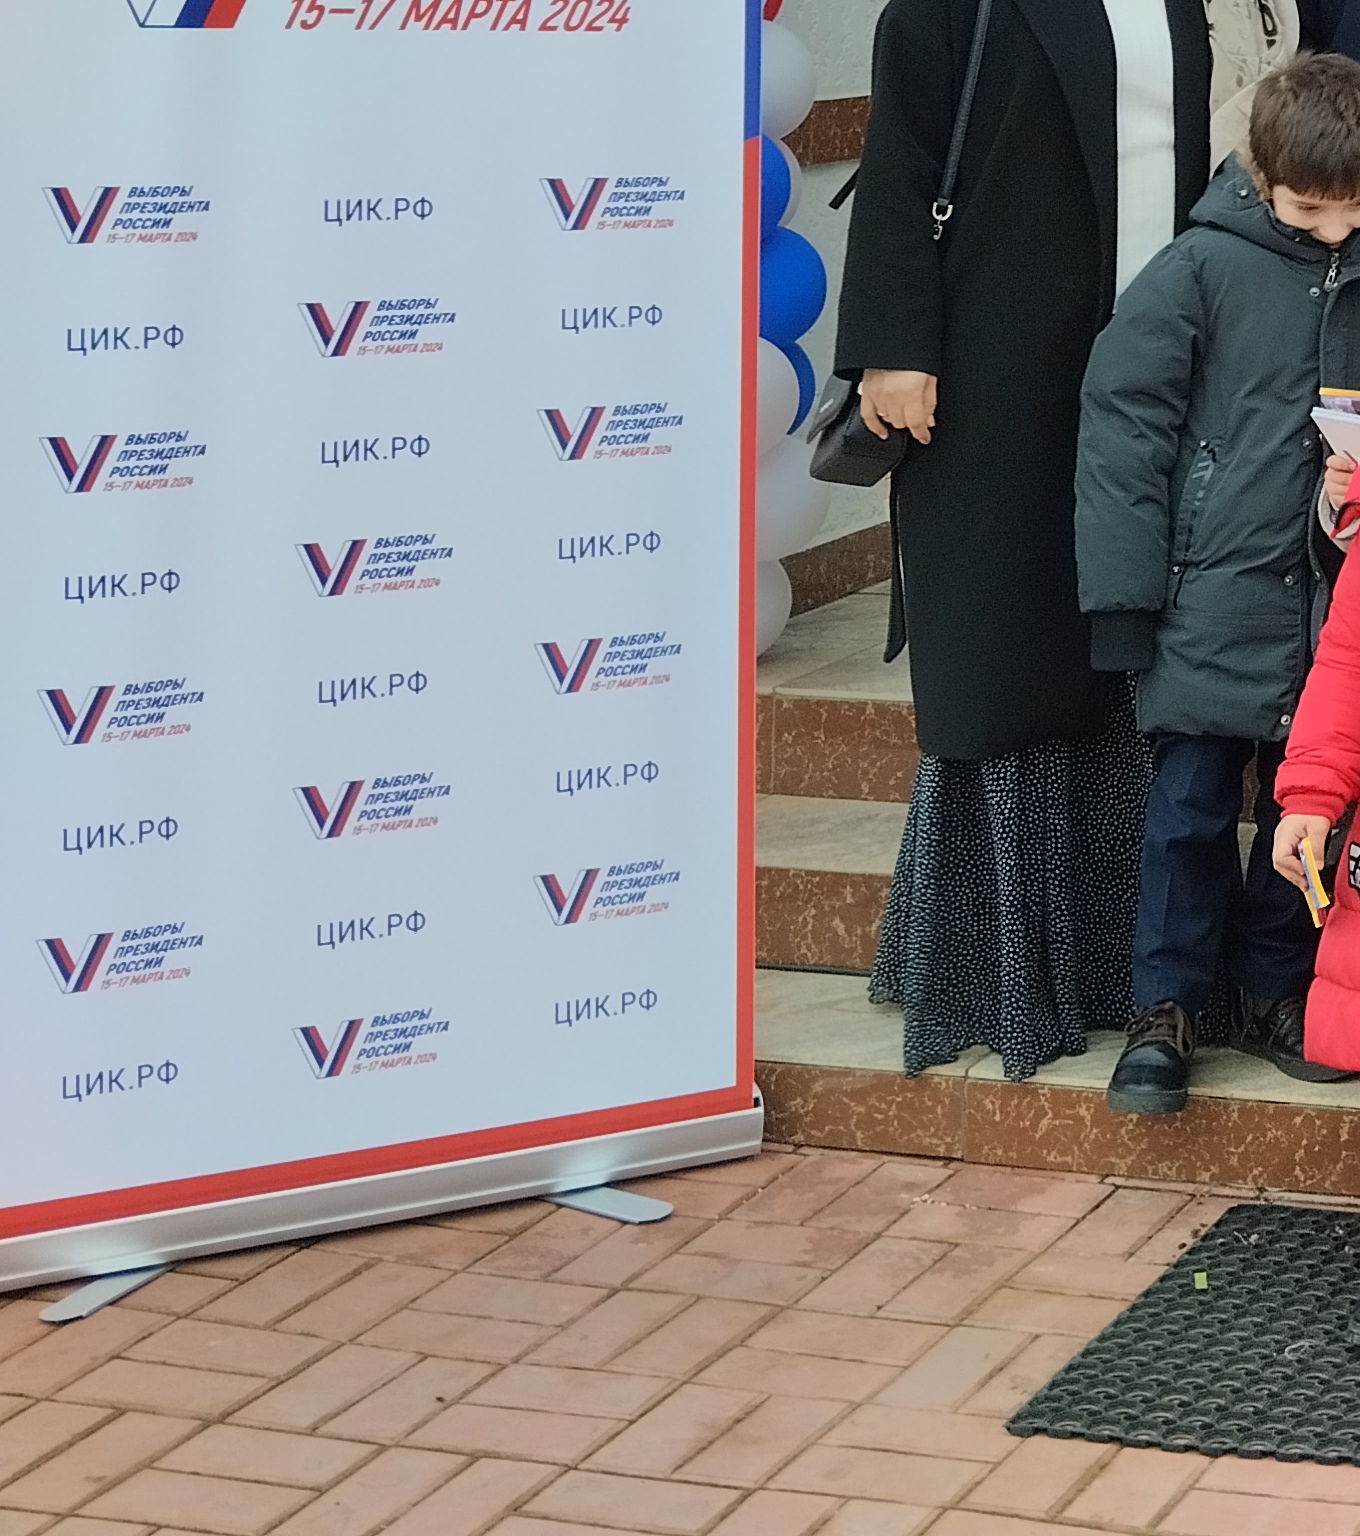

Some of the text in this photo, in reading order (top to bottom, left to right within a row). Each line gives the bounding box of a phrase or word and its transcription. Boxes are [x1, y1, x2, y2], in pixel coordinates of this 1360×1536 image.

[614, 177, 671, 189] ВЫБОРЫ
[127, 186, 194, 199] ВЫБОРЫ
[607, 190, 686, 204] ПРЕЗИДЕНТА
[119, 201, 212, 216] ПРЕЗИДЕНТА
[324, 197, 433, 226] ЦИК.РФ
[600, 205, 654, 218] РОССИИ
[111, 217, 174, 230] РОССИИ
[621, 219, 653, 230] МАРТА
[653, 218, 675, 228] 2024
[136, 232, 173, 243] МАРТА
[173, 231, 199, 242] 2024
[377, 299, 439, 312] ВЫБОРЫ
[369, 313, 455, 327] ПРЕЗИДЕНТА
[562, 304, 662, 334] ЦИК.РФ
[67, 324, 184, 356] ЦИК.РФ
[362, 328, 420, 343] РОССИИ
[385, 343, 419, 355] МАРТА
[419, 341, 443, 353] 2024
[611, 403, 669, 417] ВЫБОРЫ
[604, 416, 685, 432] ПРЕЗИДЕНТА
[124, 432, 191, 446] ВЫБОРЫ
[598, 432, 652, 447] РОССИИ
[116, 446, 208, 462] ПРЕЗИДЕНТА
[322, 435, 430, 468] ЦИК.РФ
[619, 445, 651, 458] МАРТА
[651, 444, 673, 455] 2024
[109, 463, 170, 479] РОССИИ
[133, 478, 169, 491] МАРТА
[169, 476, 195, 488] 2024
[374, 534, 436, 550] ВЫБОРЫ
[559, 531, 661, 563] ЦИК.РФ
[367, 547, 452, 565] ПРЕЗИДЕНТА
[359, 565, 417, 581] РОССИИ
[65, 569, 180, 604] ЦИК.РФ
[382, 579, 416, 592] МАРТА
[416, 576, 440, 589] 2024
[609, 632, 667, 648] ВЫБОРЫ
[602, 645, 683, 664] ПРЕЗИДЕНТА
[595, 662, 649, 679] РОССИИ
[122, 679, 187, 696] ВЫБОРЫ
[319, 671, 427, 707] ЦИК.РФ
[616, 676, 649, 689] МАРТА
[648, 673, 671, 685] 2024
[114, 692, 205, 713] ПРЕЗИДЕНТА
[106, 711, 167, 729] РОССИИ
[130, 726, 166, 740] МАРТА
[166, 723, 192, 736] 2024
[372, 773, 434, 790] ВЫБОРЫ
[557, 761, 659, 796] ЦИК.РФ
[364, 785, 450, 806] ПРЕЗИДЕНТА
[357, 804, 415, 823] РОССИИ
[380, 818, 414, 833] МАРТА
[414, 815, 438, 828] 2024
[63, 816, 178, 855] ЦИК.РФ
[607, 860, 665, 878] ВЫБОРЫ
[600, 872, 681, 893] ПРЕЗИДЕНТА
[593, 890, 647, 909] РОССИИ
[614, 904, 647, 919] МАРТА
[646, 901, 670, 914] 2024
[120, 923, 186, 942] ВЫБОРЫ
[317, 910, 425, 949] ЦИК.РФ
[113, 936, 203, 959] ПРЕЗИДЕНТА
[105, 955, 166, 976] РОССИИ
[129, 970, 165, 986] МАРТА
[165, 966, 191, 981] 2024
[555, 989, 657, 1027] ЦИК.РФ
[371, 1009, 432, 1028] ВЫБОРЫ
[363, 1021, 449, 1045] ПРЕЗИДЕНТА
[356, 1040, 414, 1061] РОССИИ
[379, 1055, 413, 1070] МАРТА
[413, 1051, 437, 1065] 2024
[63, 1060, 178, 1102] ЦИК.РФ
